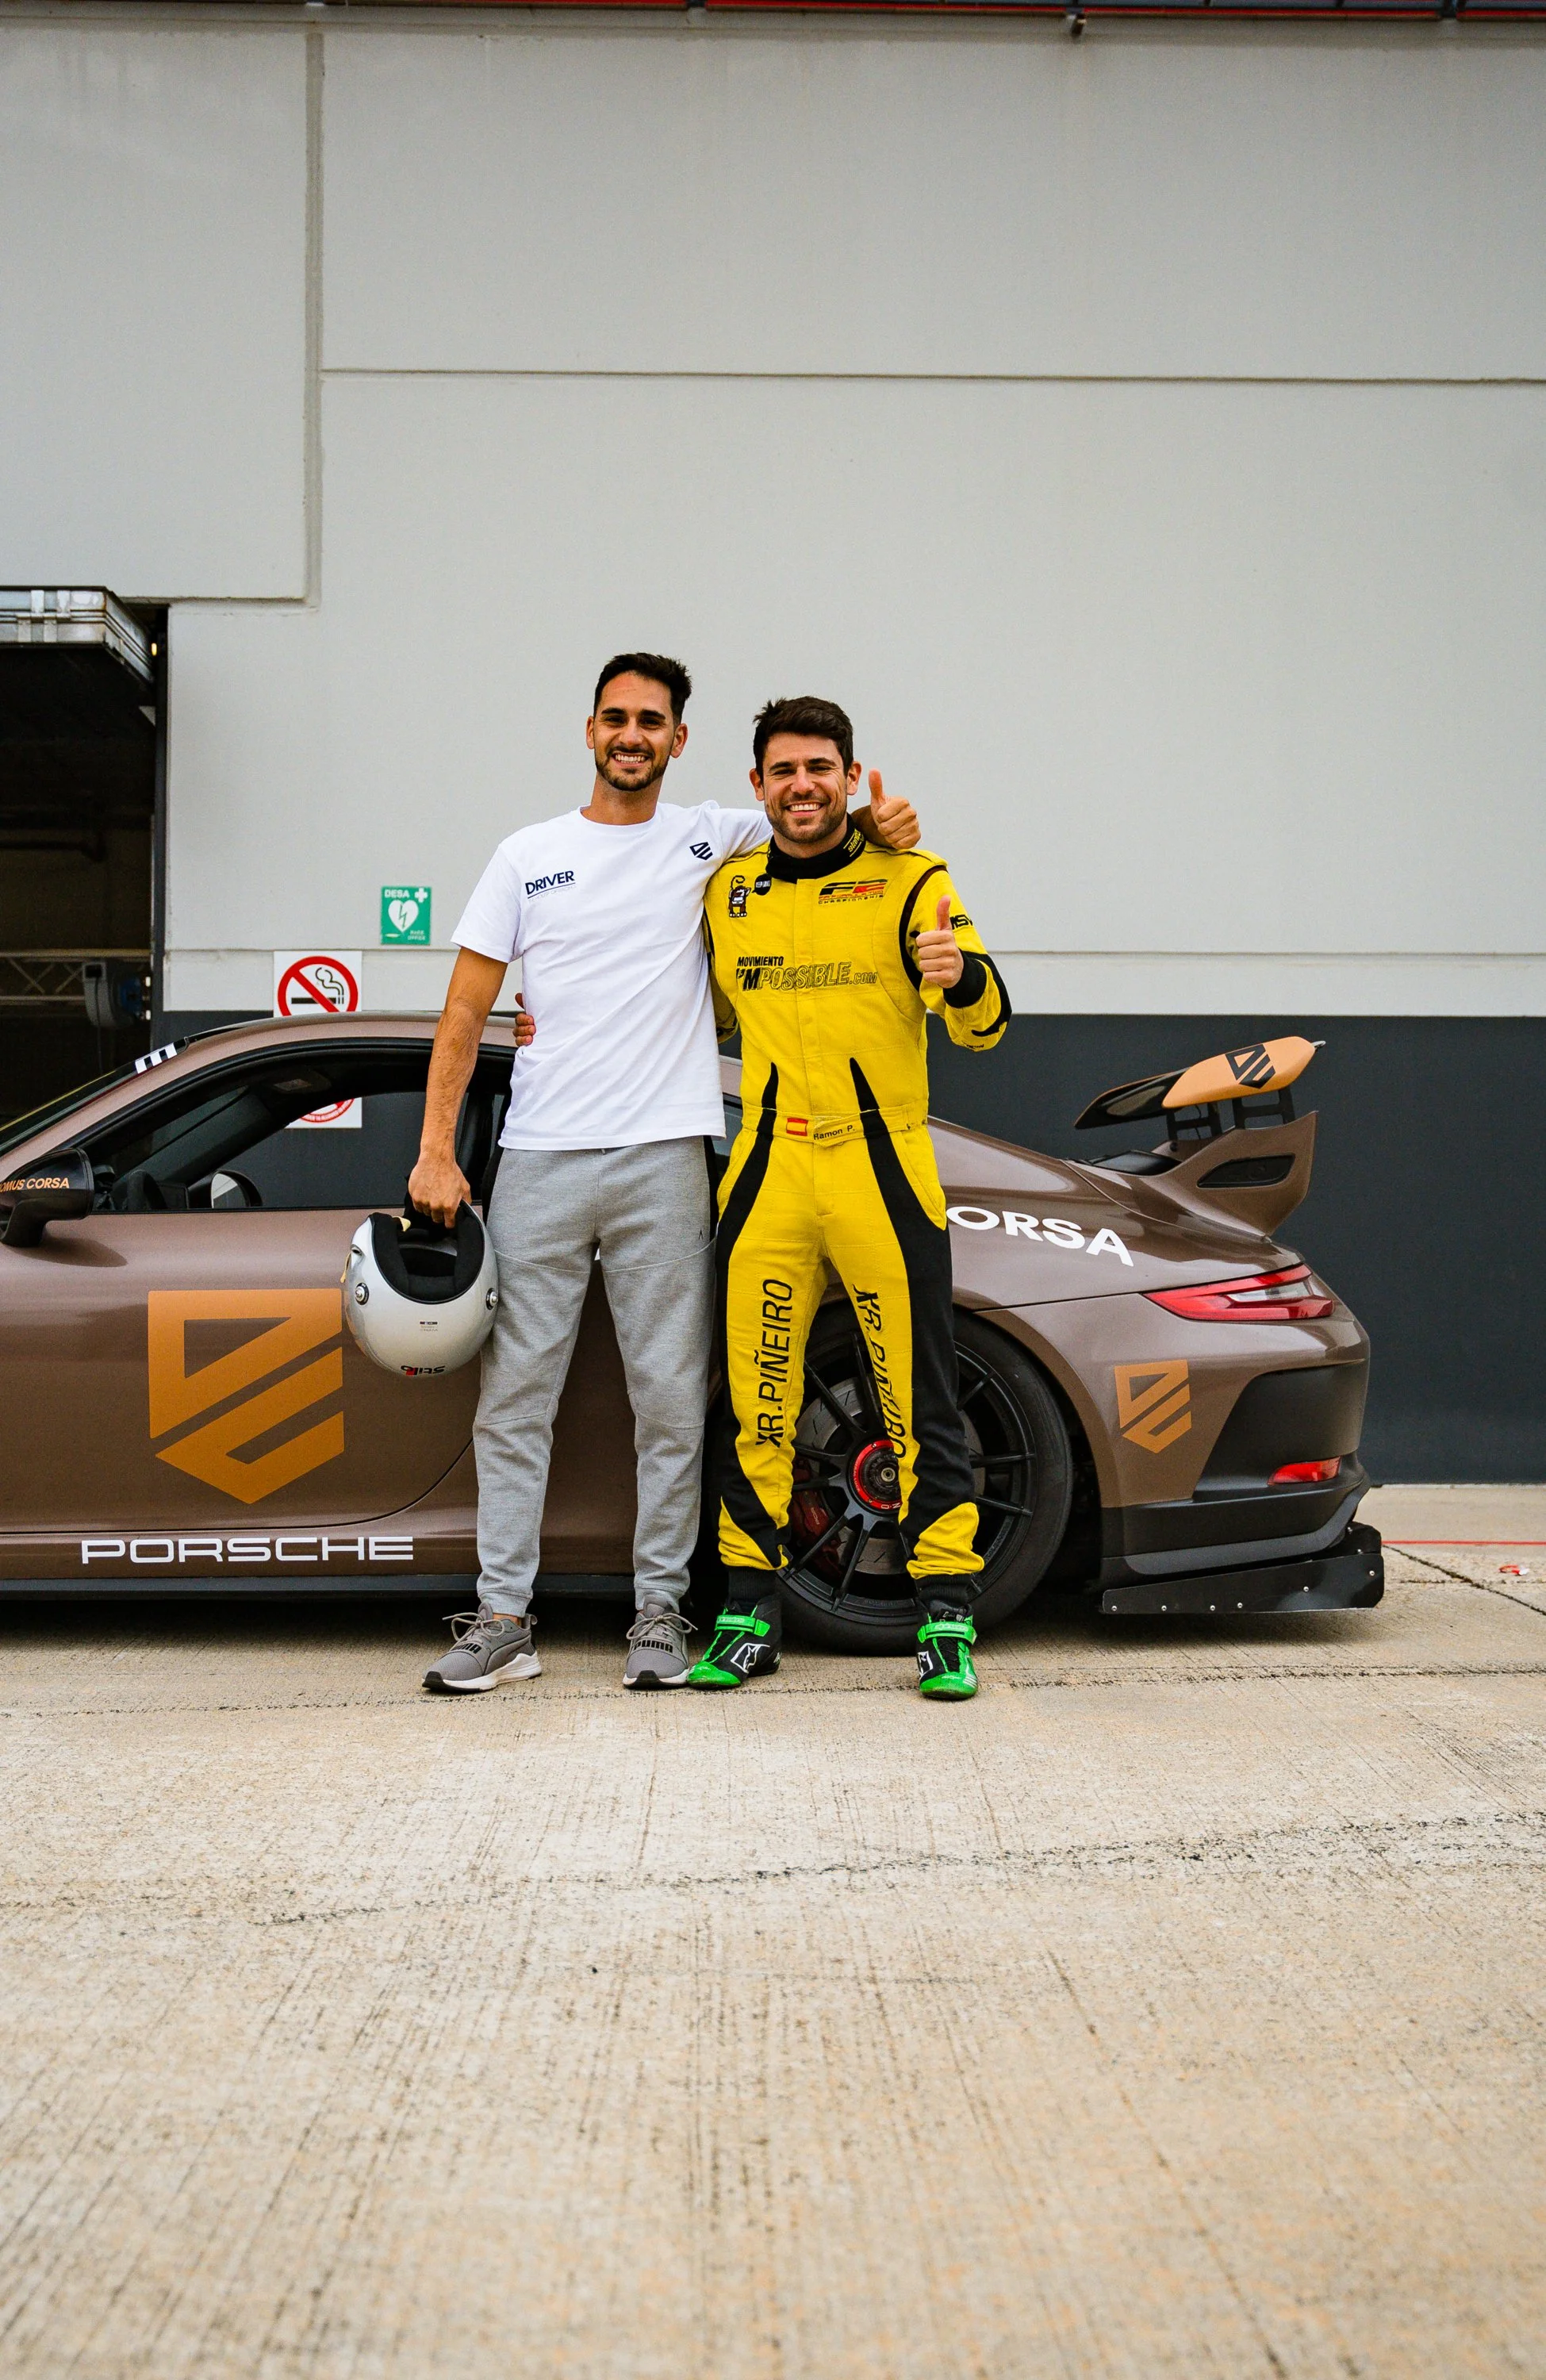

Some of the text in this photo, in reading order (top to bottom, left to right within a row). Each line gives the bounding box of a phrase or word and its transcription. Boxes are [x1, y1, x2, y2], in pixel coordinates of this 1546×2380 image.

[525, 870, 576, 896] DRIVER
[384, 889, 410, 898] DESA
[737, 956, 785, 967] MOVIMIENTO
[814, 1128, 843, 1140] Ramon
[0, 1177, 70, 1192] OMUS CORSA
[946, 1206, 1134, 1267] ORSA
[81, 1536, 413, 1564] PORSCHE
[634, 1639, 673, 1654] PUMA
